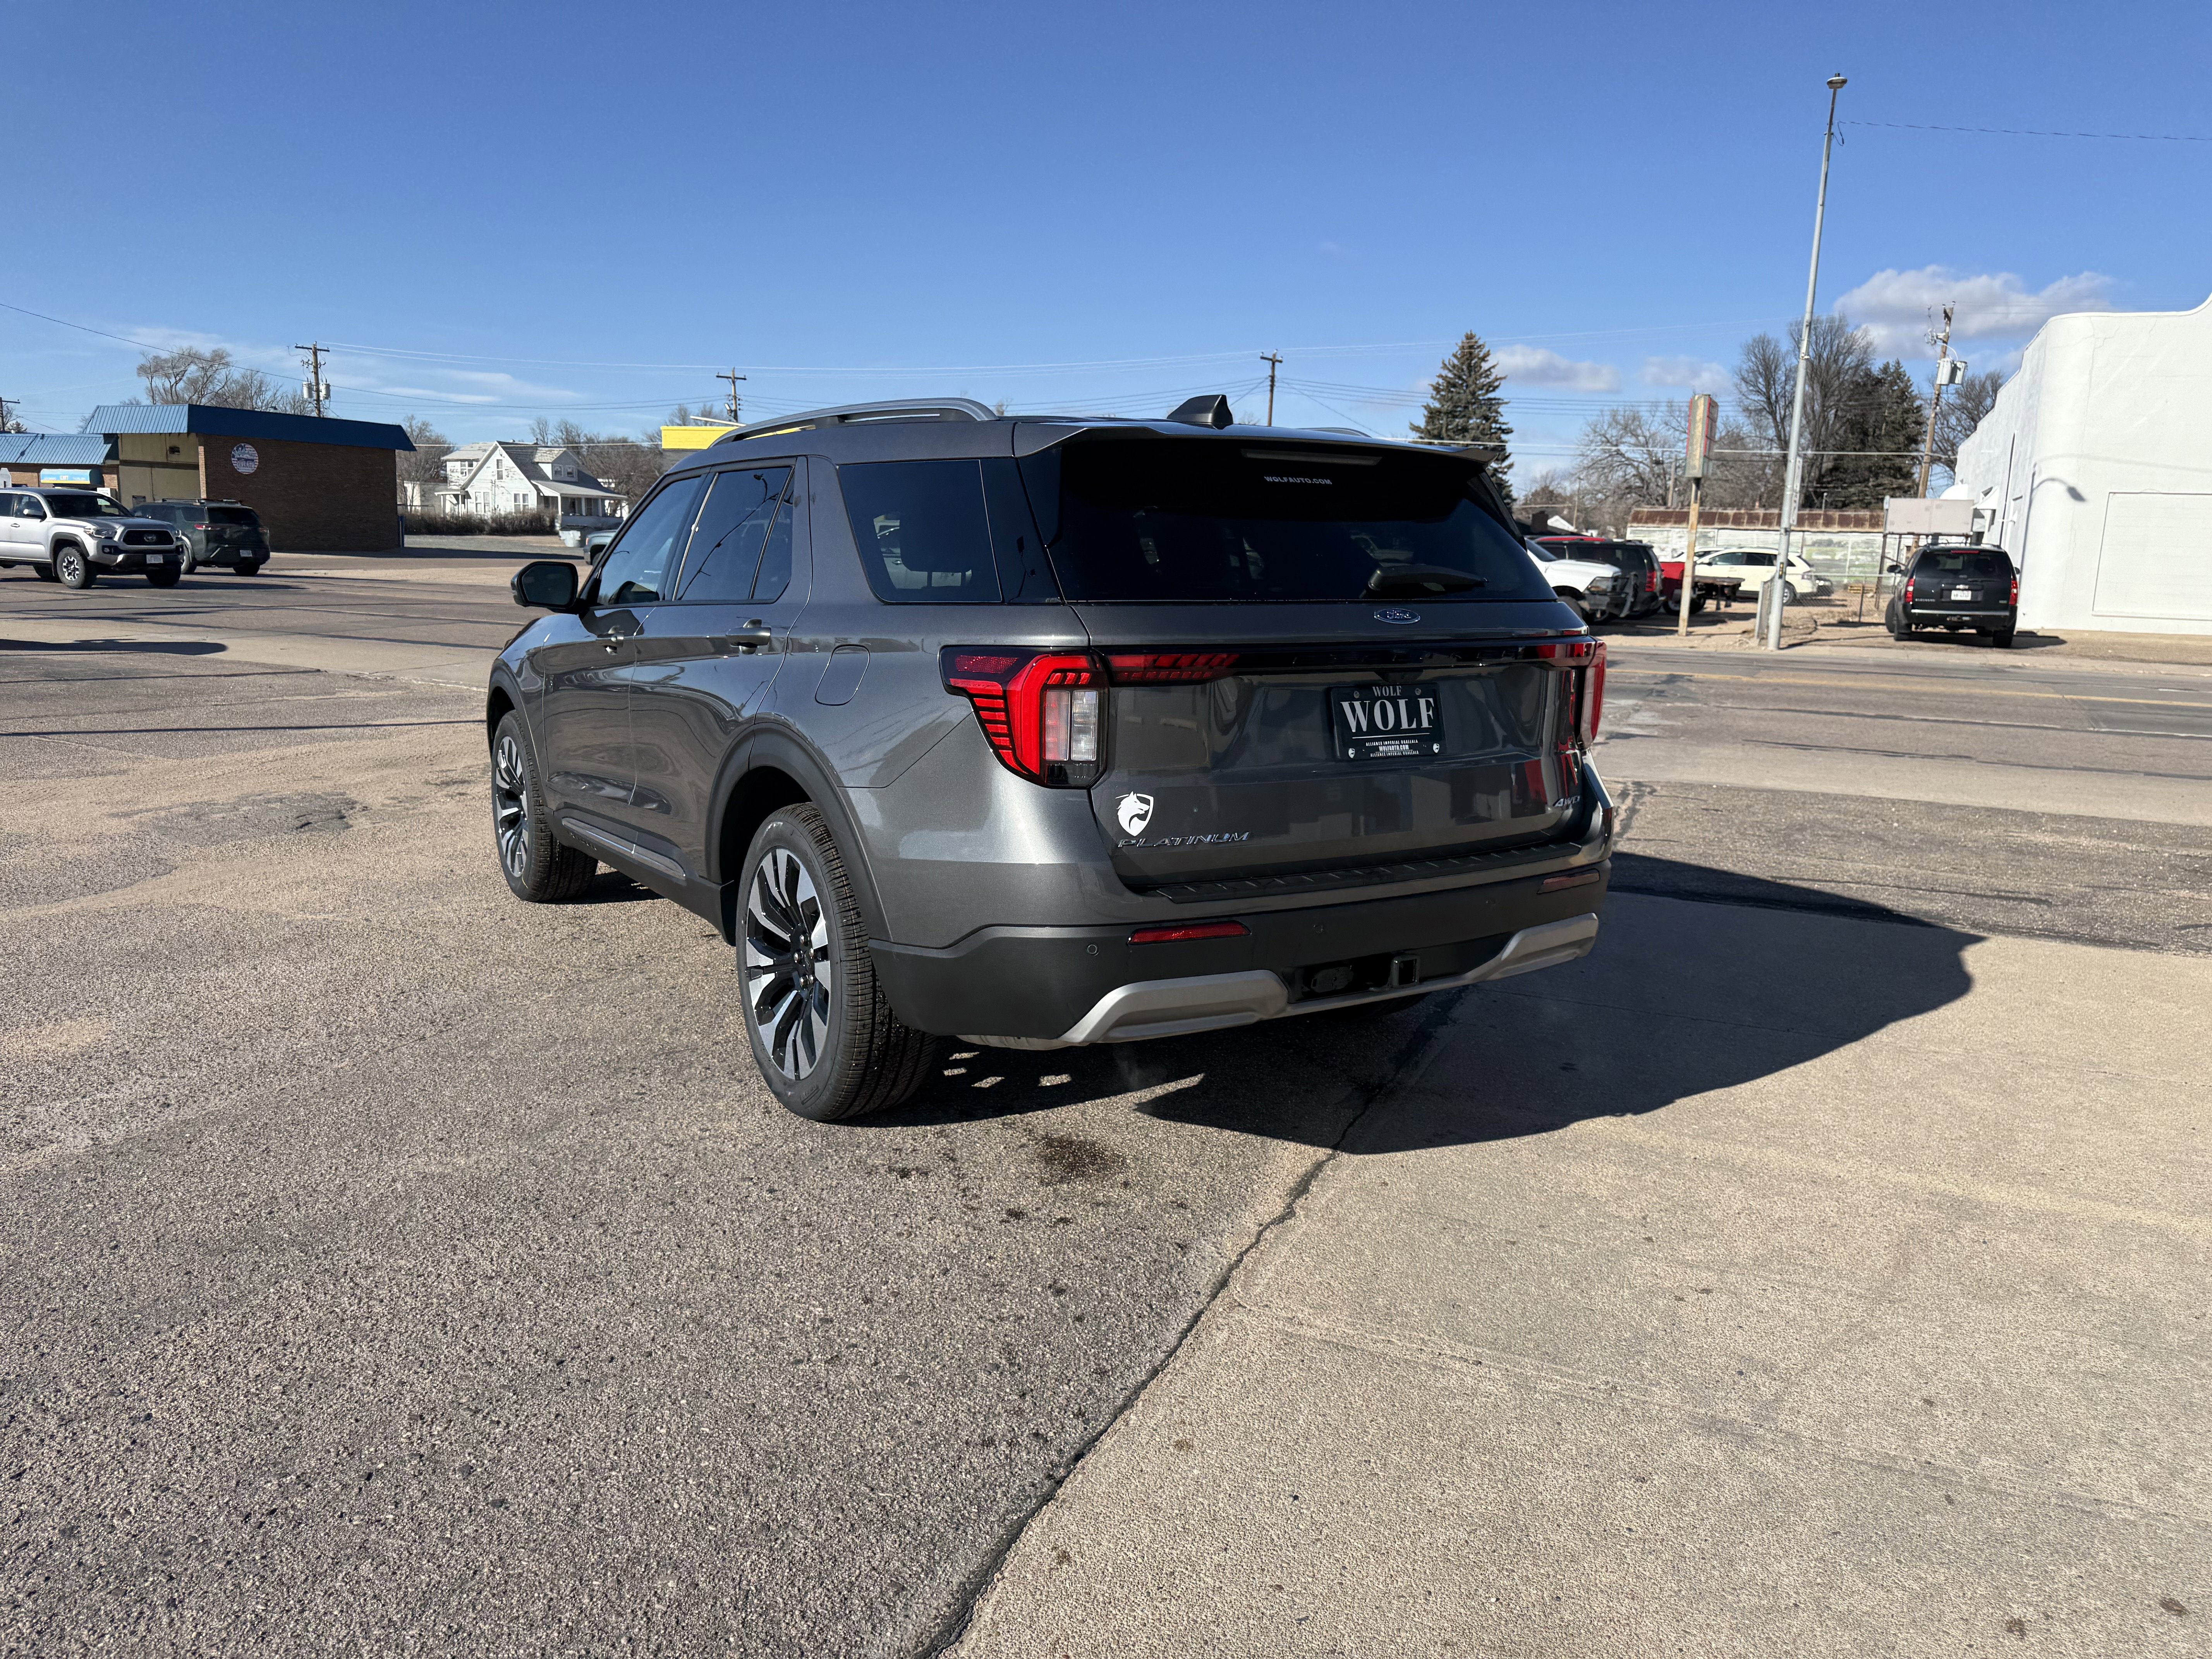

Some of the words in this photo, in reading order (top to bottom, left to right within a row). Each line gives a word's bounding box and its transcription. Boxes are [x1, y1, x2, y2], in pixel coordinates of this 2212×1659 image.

[1264, 476, 1333, 484] WOLFAUTO.COM
[1372, 685, 1402, 697] WOLF
[1340, 697, 1434, 733] WOLF
[1118, 831, 1251, 848] PLATINUM
